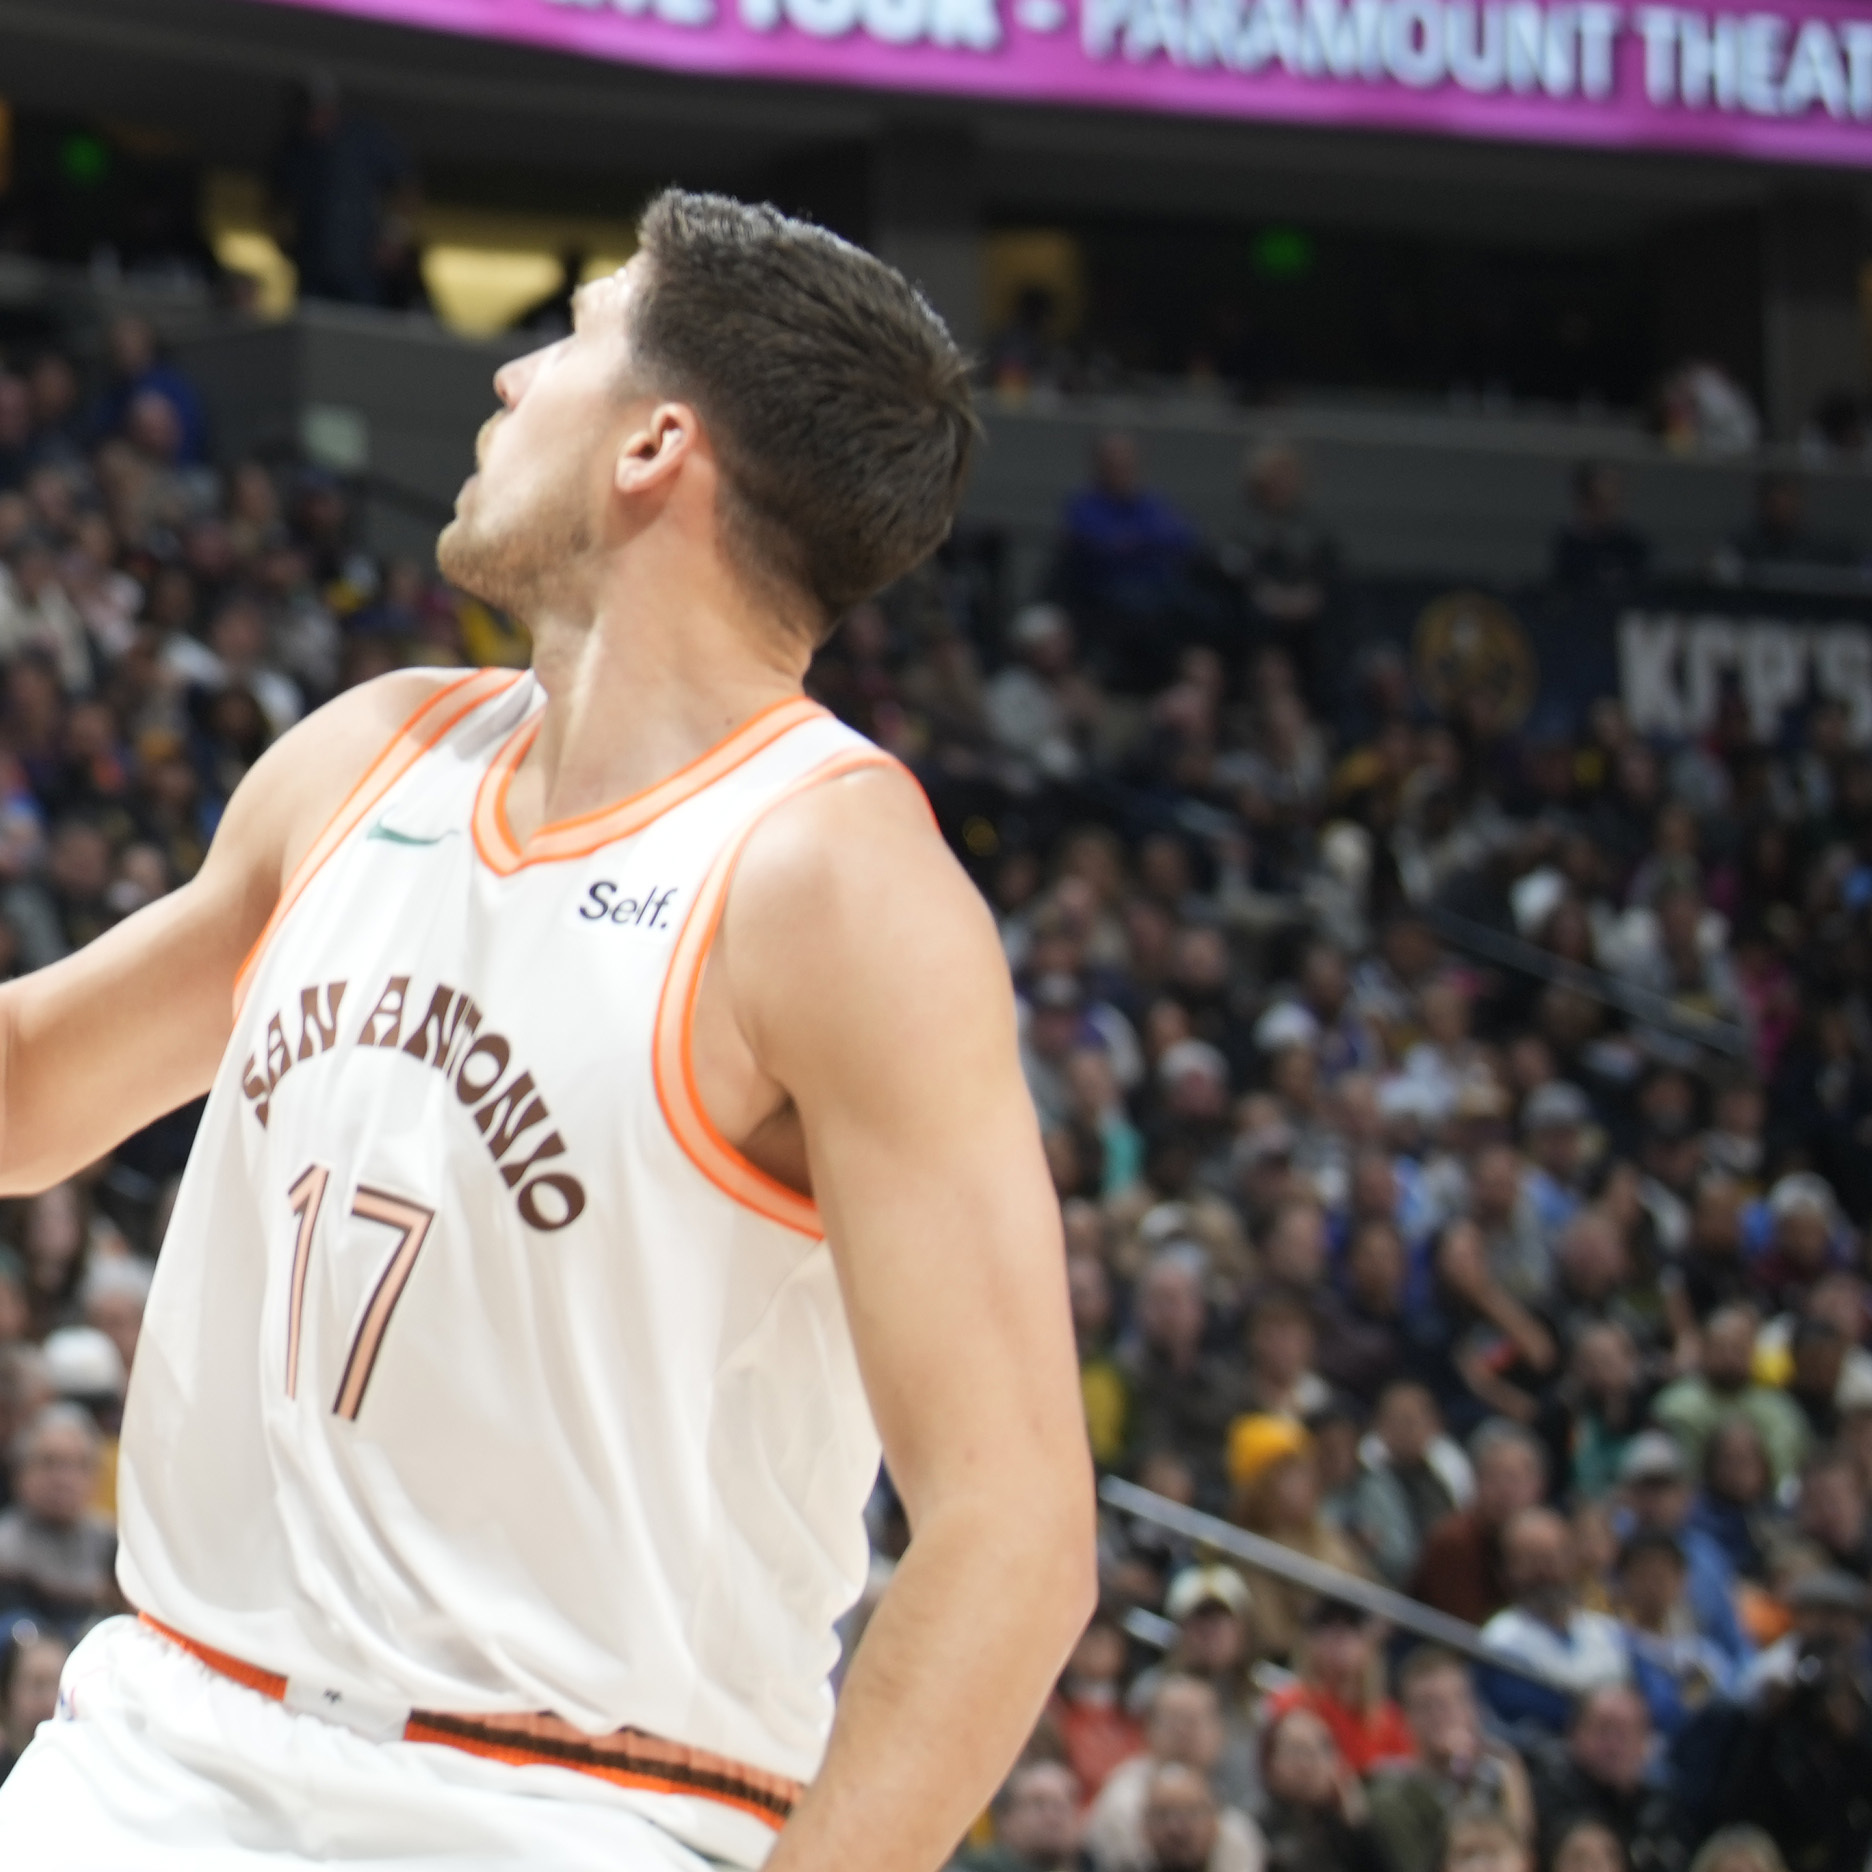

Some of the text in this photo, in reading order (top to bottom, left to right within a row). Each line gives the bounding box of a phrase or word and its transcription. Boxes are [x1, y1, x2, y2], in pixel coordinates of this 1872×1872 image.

[579, 879, 679, 931] Self.
[241, 975, 587, 1234] SAN ANTONIO
[286, 1162, 437, 1423] 17
